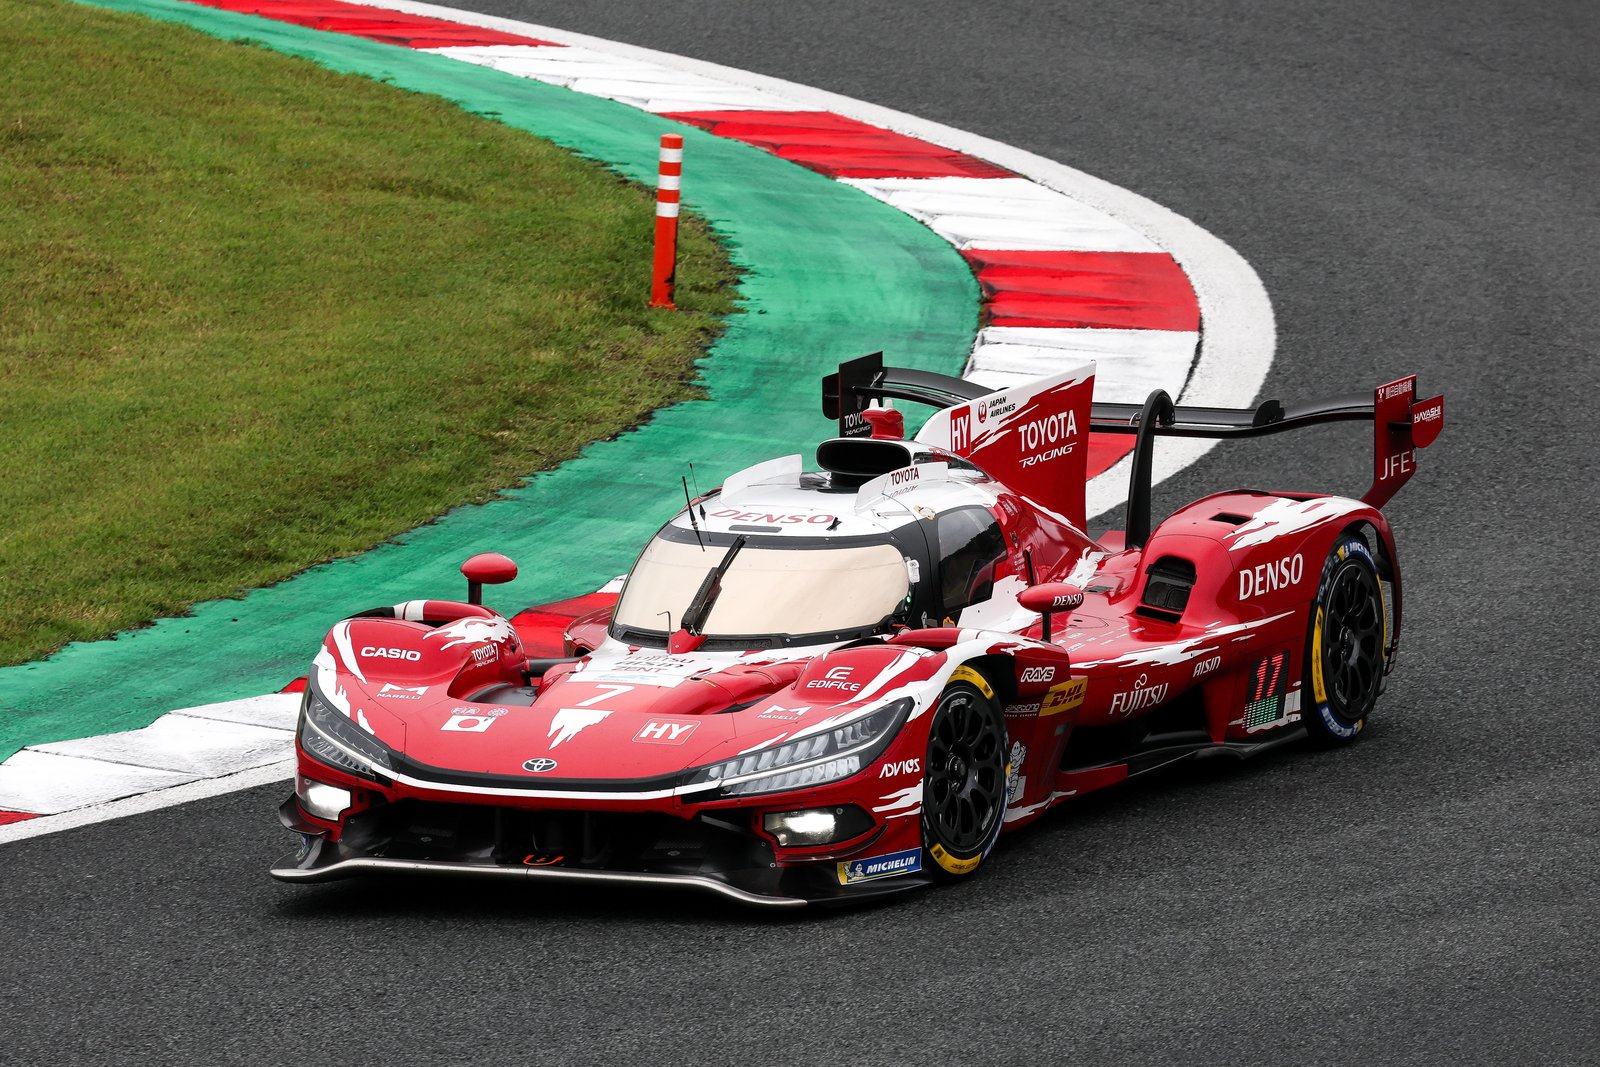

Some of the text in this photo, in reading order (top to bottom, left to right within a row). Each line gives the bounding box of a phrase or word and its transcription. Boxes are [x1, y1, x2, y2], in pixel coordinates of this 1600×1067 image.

[989, 396, 1006, 408] JAPAN
[990, 403, 1015, 418] AIRLINES
[844, 411, 869, 428] TOYO
[1414, 405, 1441, 423] HAYASHI
[951, 413, 970, 452] HY
[1018, 409, 1077, 452] TOYOTA
[1019, 442, 1077, 468] RACING
[1380, 451, 1410, 480] JFE
[890, 467, 919, 486] TOYOTA
[709, 508, 833, 524] DENSO
[1239, 553, 1303, 601] DENSO
[1052, 593, 1083, 606] DENSO
[360, 646, 421, 661] CASIO
[471, 643, 495, 662] TOYOTA
[1021, 667, 1056, 682] RAYS
[1193, 656, 1221, 678] AISIN
[575, 684, 635, 706] 7
[806, 680, 861, 692] EDIFICE
[1050, 683, 1083, 707] DHL
[377, 692, 421, 700] MARELLI
[1109, 682, 1169, 717] FUJITSU
[757, 713, 799, 721] MARELLI
[639, 722, 694, 740] HY
[879, 758, 921, 779] ADVICS
[866, 855, 916, 874] MICHELIN
